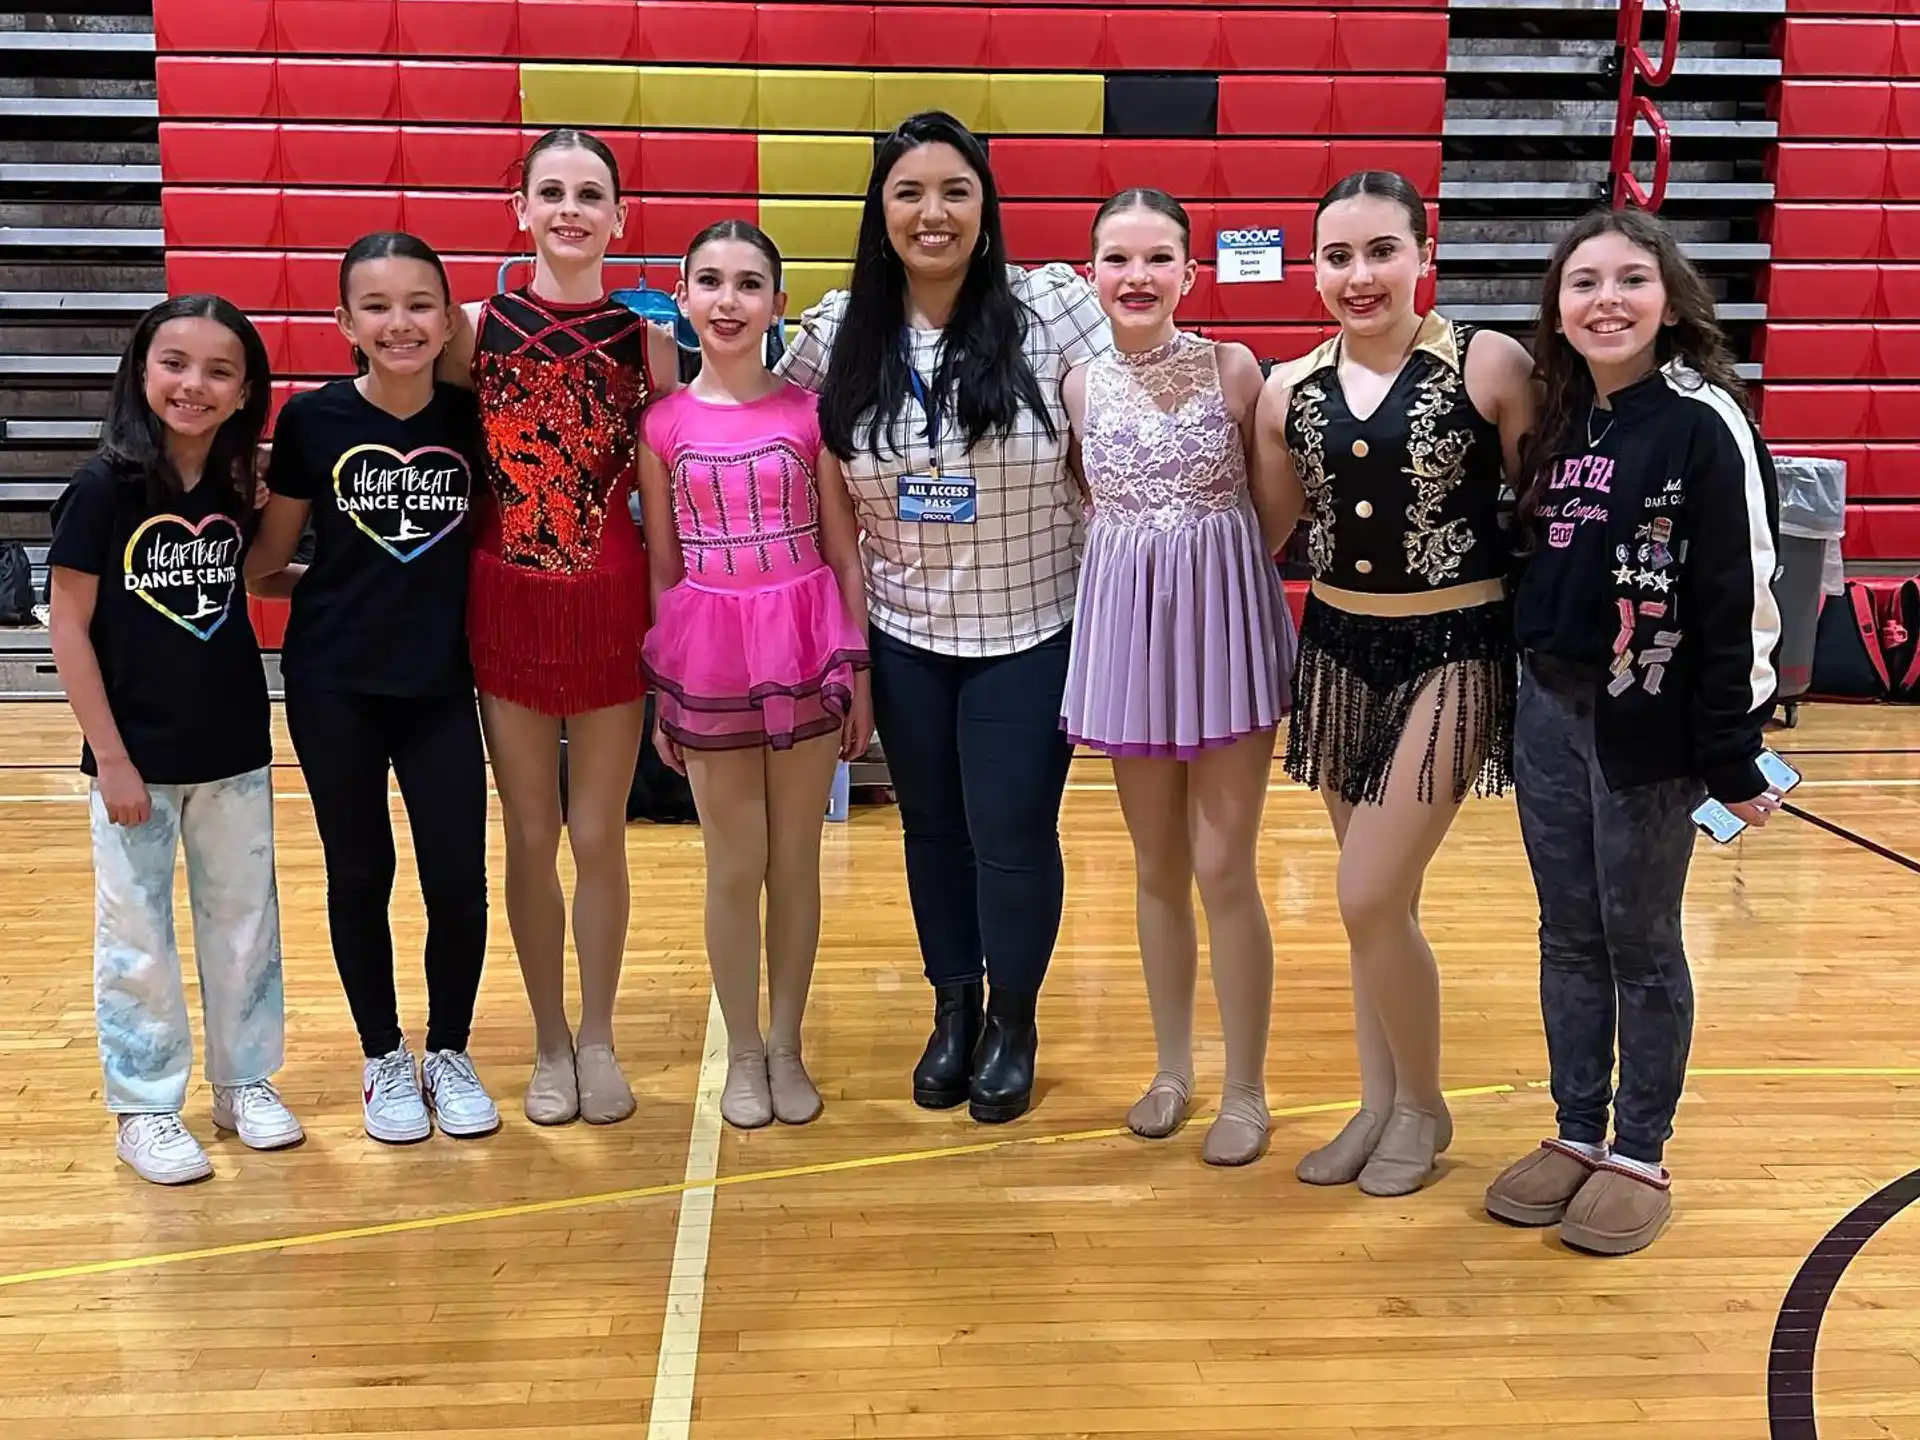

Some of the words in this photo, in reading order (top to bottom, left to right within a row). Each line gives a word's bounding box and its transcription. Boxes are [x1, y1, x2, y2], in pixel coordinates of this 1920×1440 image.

[1220, 229, 1281, 244] GROOVE
[353, 459, 459, 495] HEARTBEAT
[907, 485, 927, 496] ALL
[929, 486, 969, 498] ACCESS
[336, 494, 400, 512] DANCE
[924, 499, 952, 508] PASS
[146, 532, 234, 571] HEARTBEAT
[124, 569, 195, 591] DANCE
